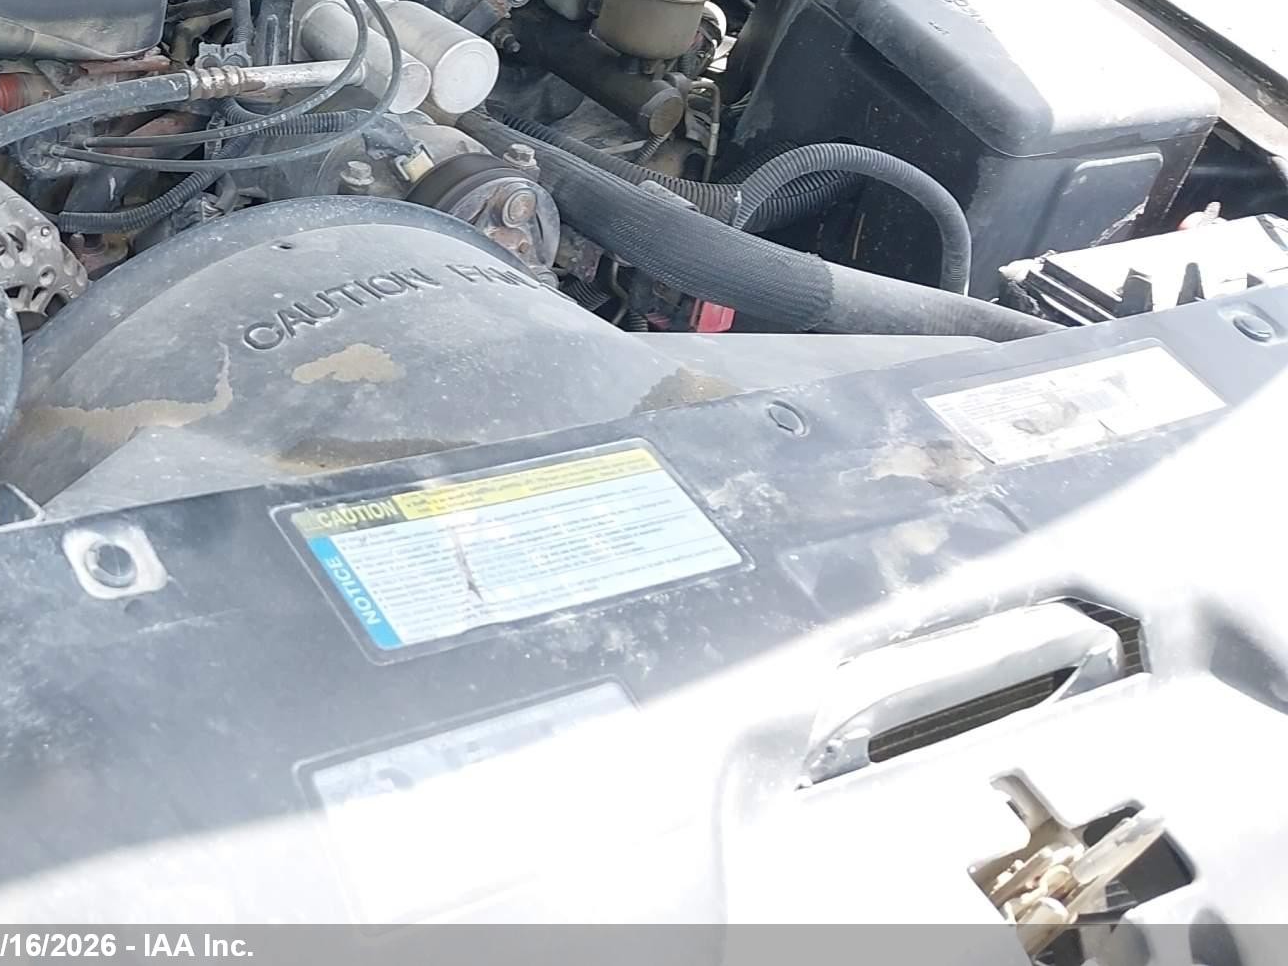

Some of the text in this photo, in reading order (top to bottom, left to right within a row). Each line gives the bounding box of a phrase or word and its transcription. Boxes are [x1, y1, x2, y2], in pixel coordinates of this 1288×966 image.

[243, 267, 441, 350] CAUTION
[316, 498, 400, 529] CAUTION
[325, 554, 382, 626] NOTICE
